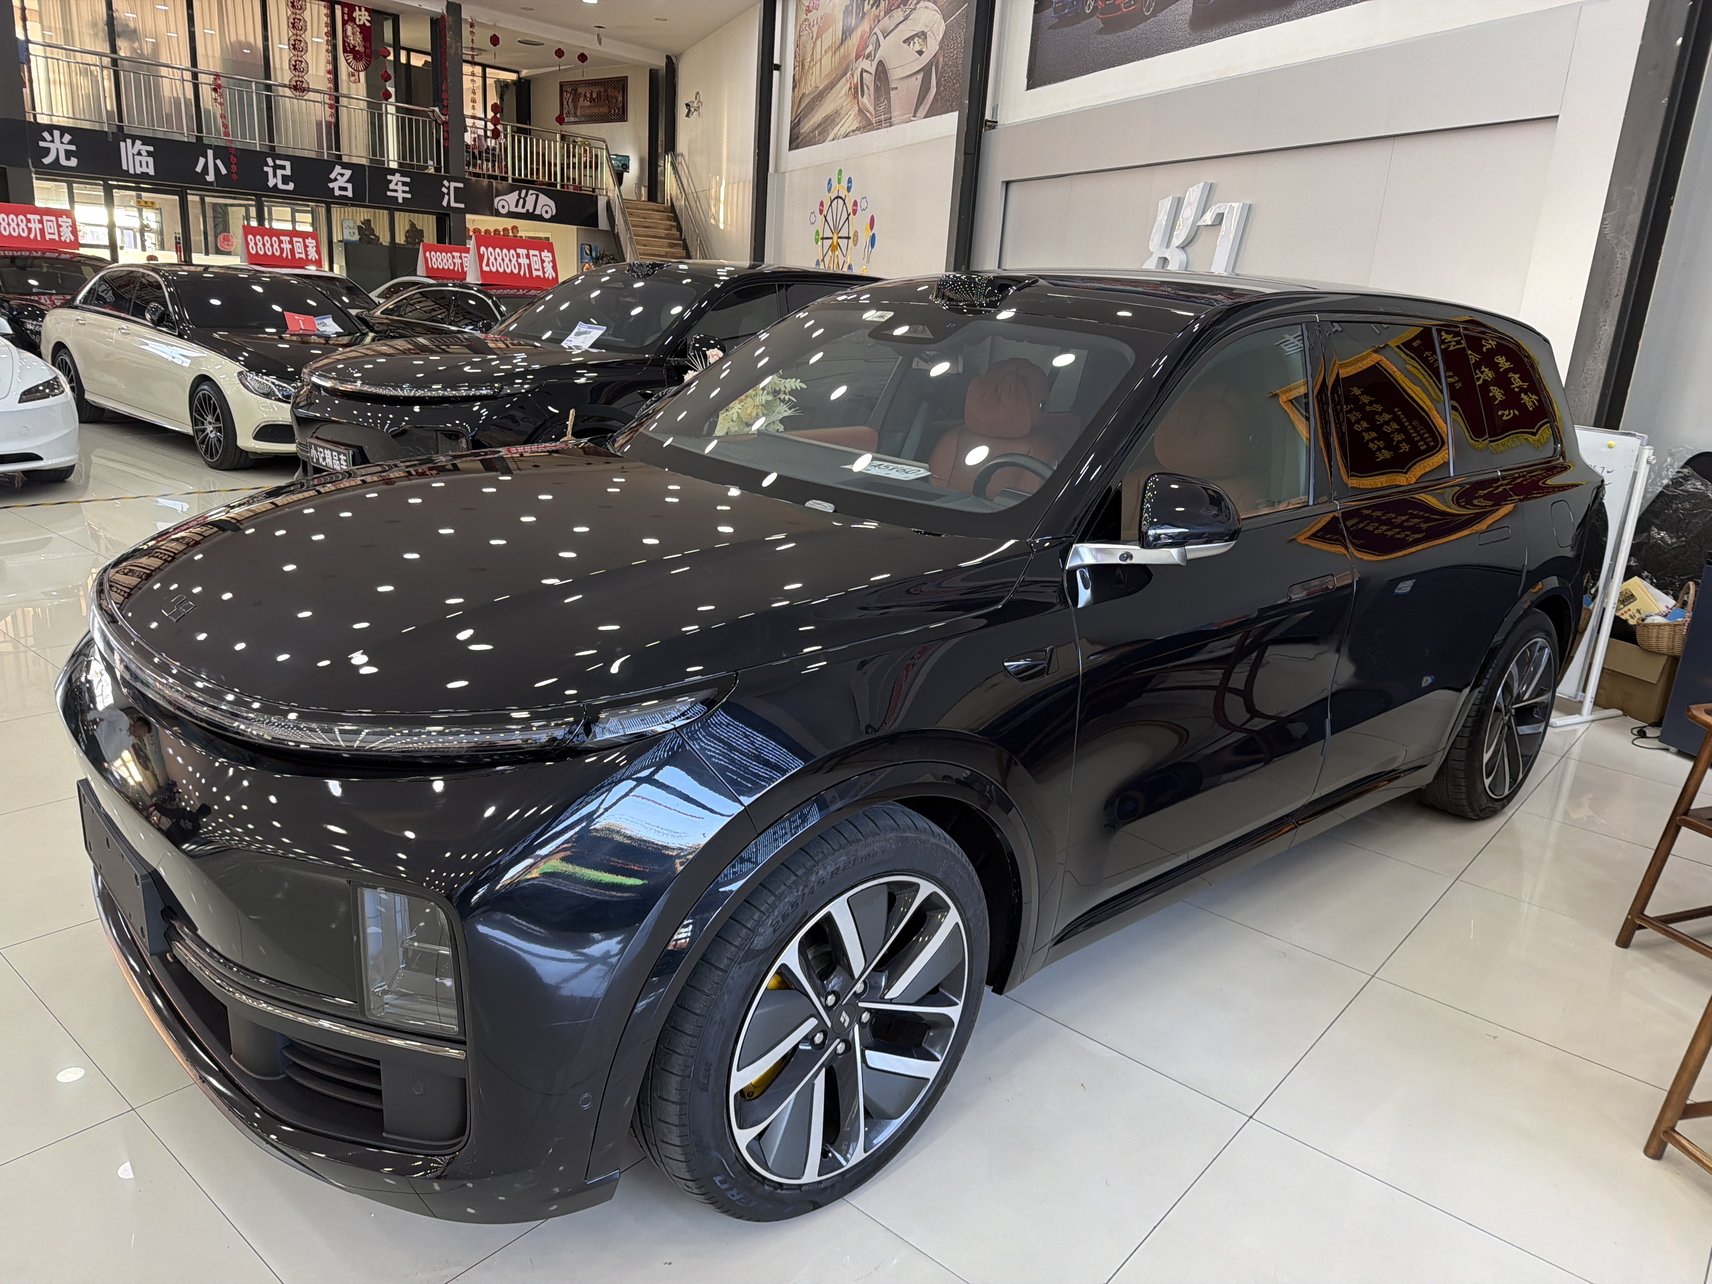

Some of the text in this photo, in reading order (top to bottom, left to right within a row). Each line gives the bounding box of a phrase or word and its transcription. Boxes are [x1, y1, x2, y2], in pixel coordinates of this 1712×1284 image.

[352, 6, 371, 27] 快
[38, 128, 465, 209] 光临小记名车汇
[247, 234, 319, 261] 8888开回家
[480, 246, 556, 280] 28888开回家
